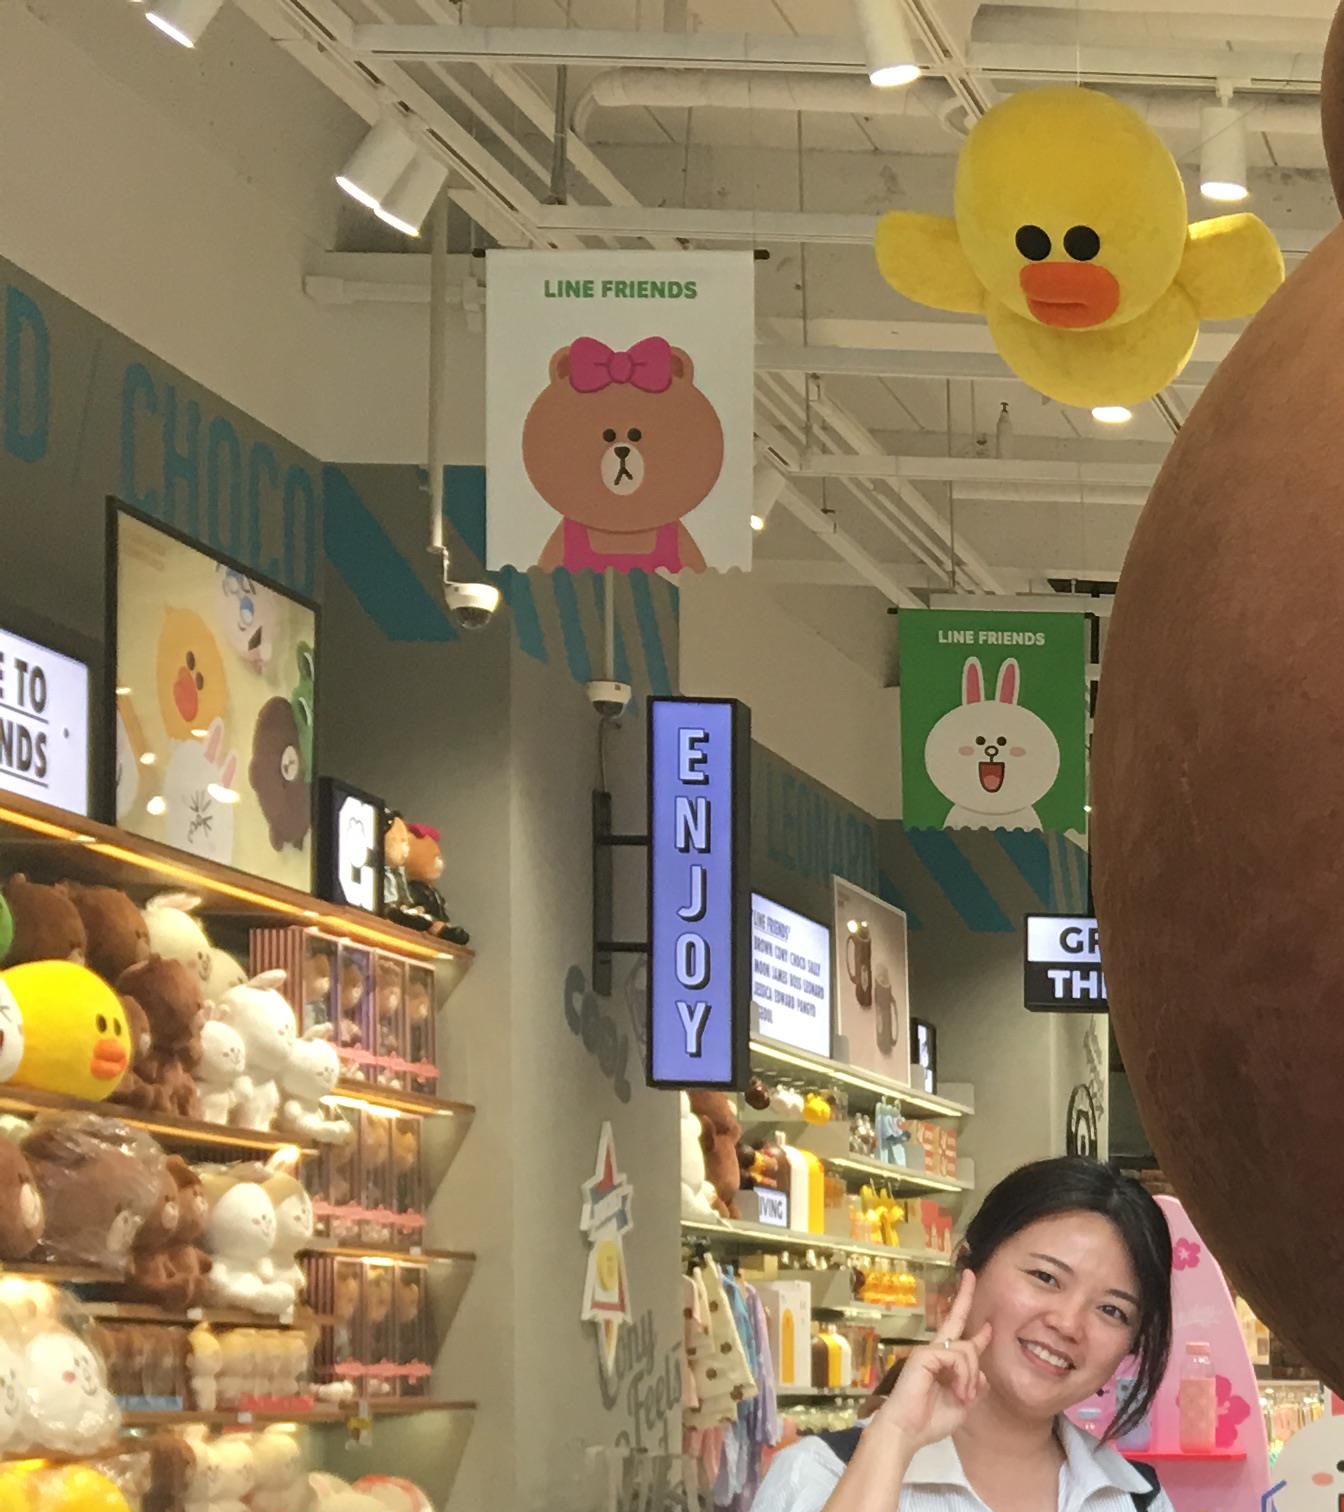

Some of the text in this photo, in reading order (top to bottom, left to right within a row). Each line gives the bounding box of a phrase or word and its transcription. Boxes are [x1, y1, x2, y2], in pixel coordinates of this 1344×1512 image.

[544, 280, 698, 299] LINE FRIENDS
[121, 363, 316, 596] CHOCO
[938, 630, 1046, 646] LINE FRIENDS
[14, 657, 47, 714] TO
[674, 728, 711, 1057] ENJOY
[1047, 970, 1107, 999] TH
